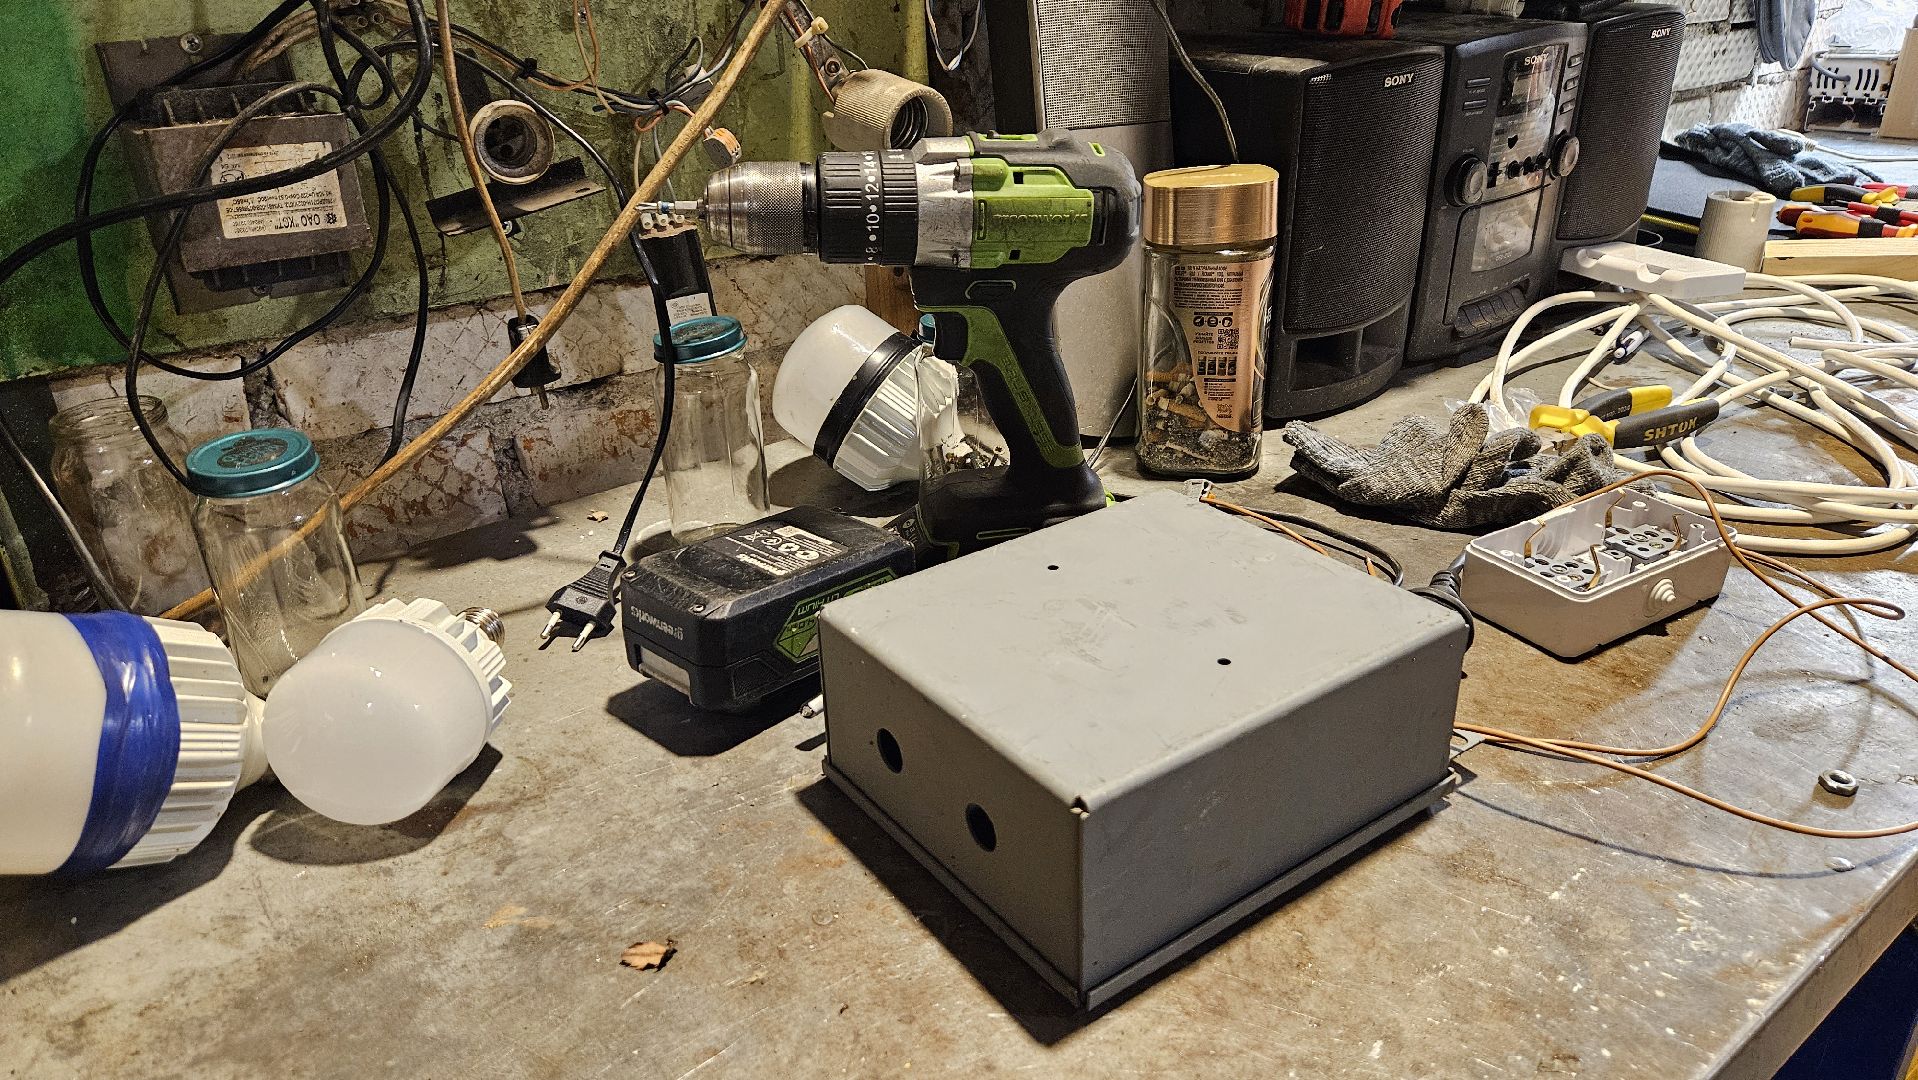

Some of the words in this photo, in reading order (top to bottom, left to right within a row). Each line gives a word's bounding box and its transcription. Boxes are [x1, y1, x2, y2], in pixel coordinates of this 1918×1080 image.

[1650, 26, 1672, 39] SONY
[1524, 53, 1550, 66] SONY
[1384, 72, 1415, 88] SONY
[865, 182, 880, 201] 12
[866, 213, 880, 232] 10
[1643, 417, 1698, 442] SHTOK
